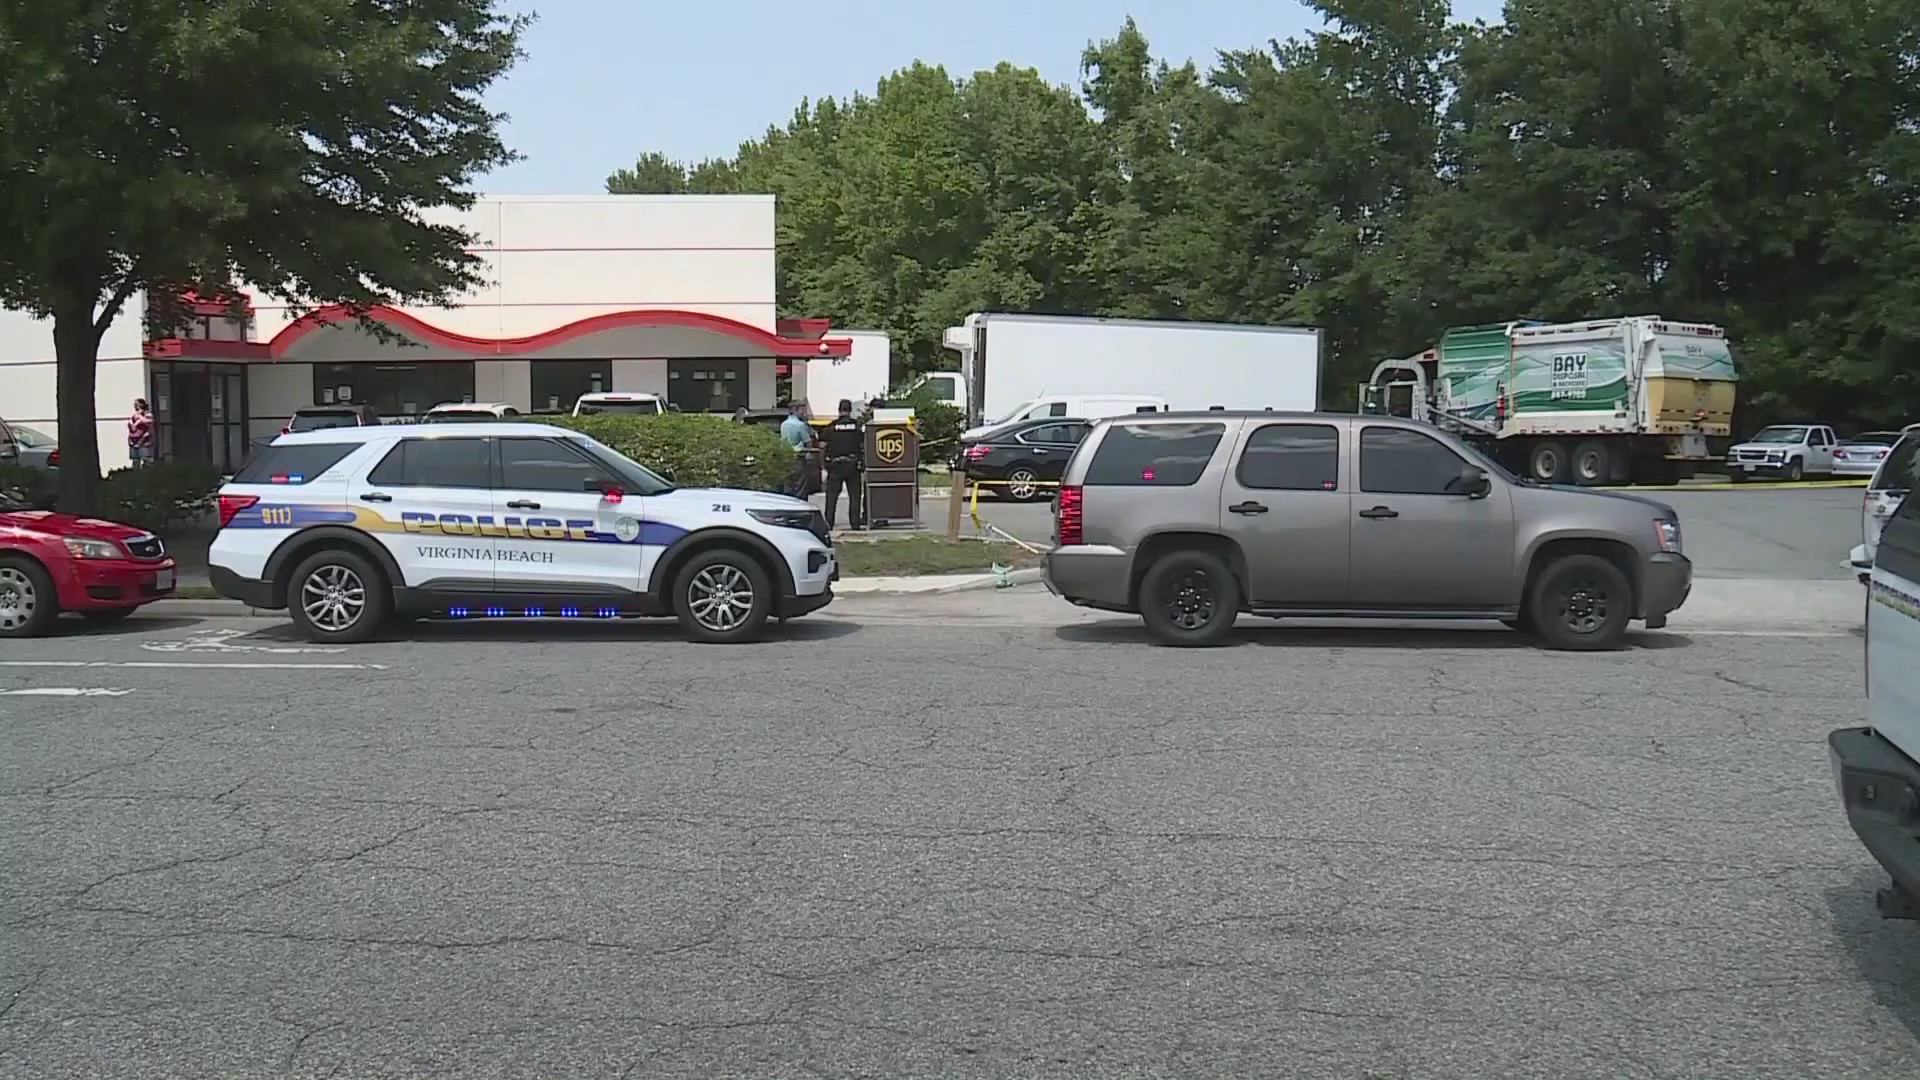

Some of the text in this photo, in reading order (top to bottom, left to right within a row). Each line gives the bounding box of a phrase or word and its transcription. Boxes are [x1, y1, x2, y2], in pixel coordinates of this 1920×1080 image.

[1553, 355, 1586, 372] BAY
[834, 423, 856, 431] POLICE
[879, 438, 902, 458] ups
[711, 503, 731, 513] 26
[401, 511, 600, 541] POLICE
[417, 546, 554, 564] VIRGINIA BEACH
